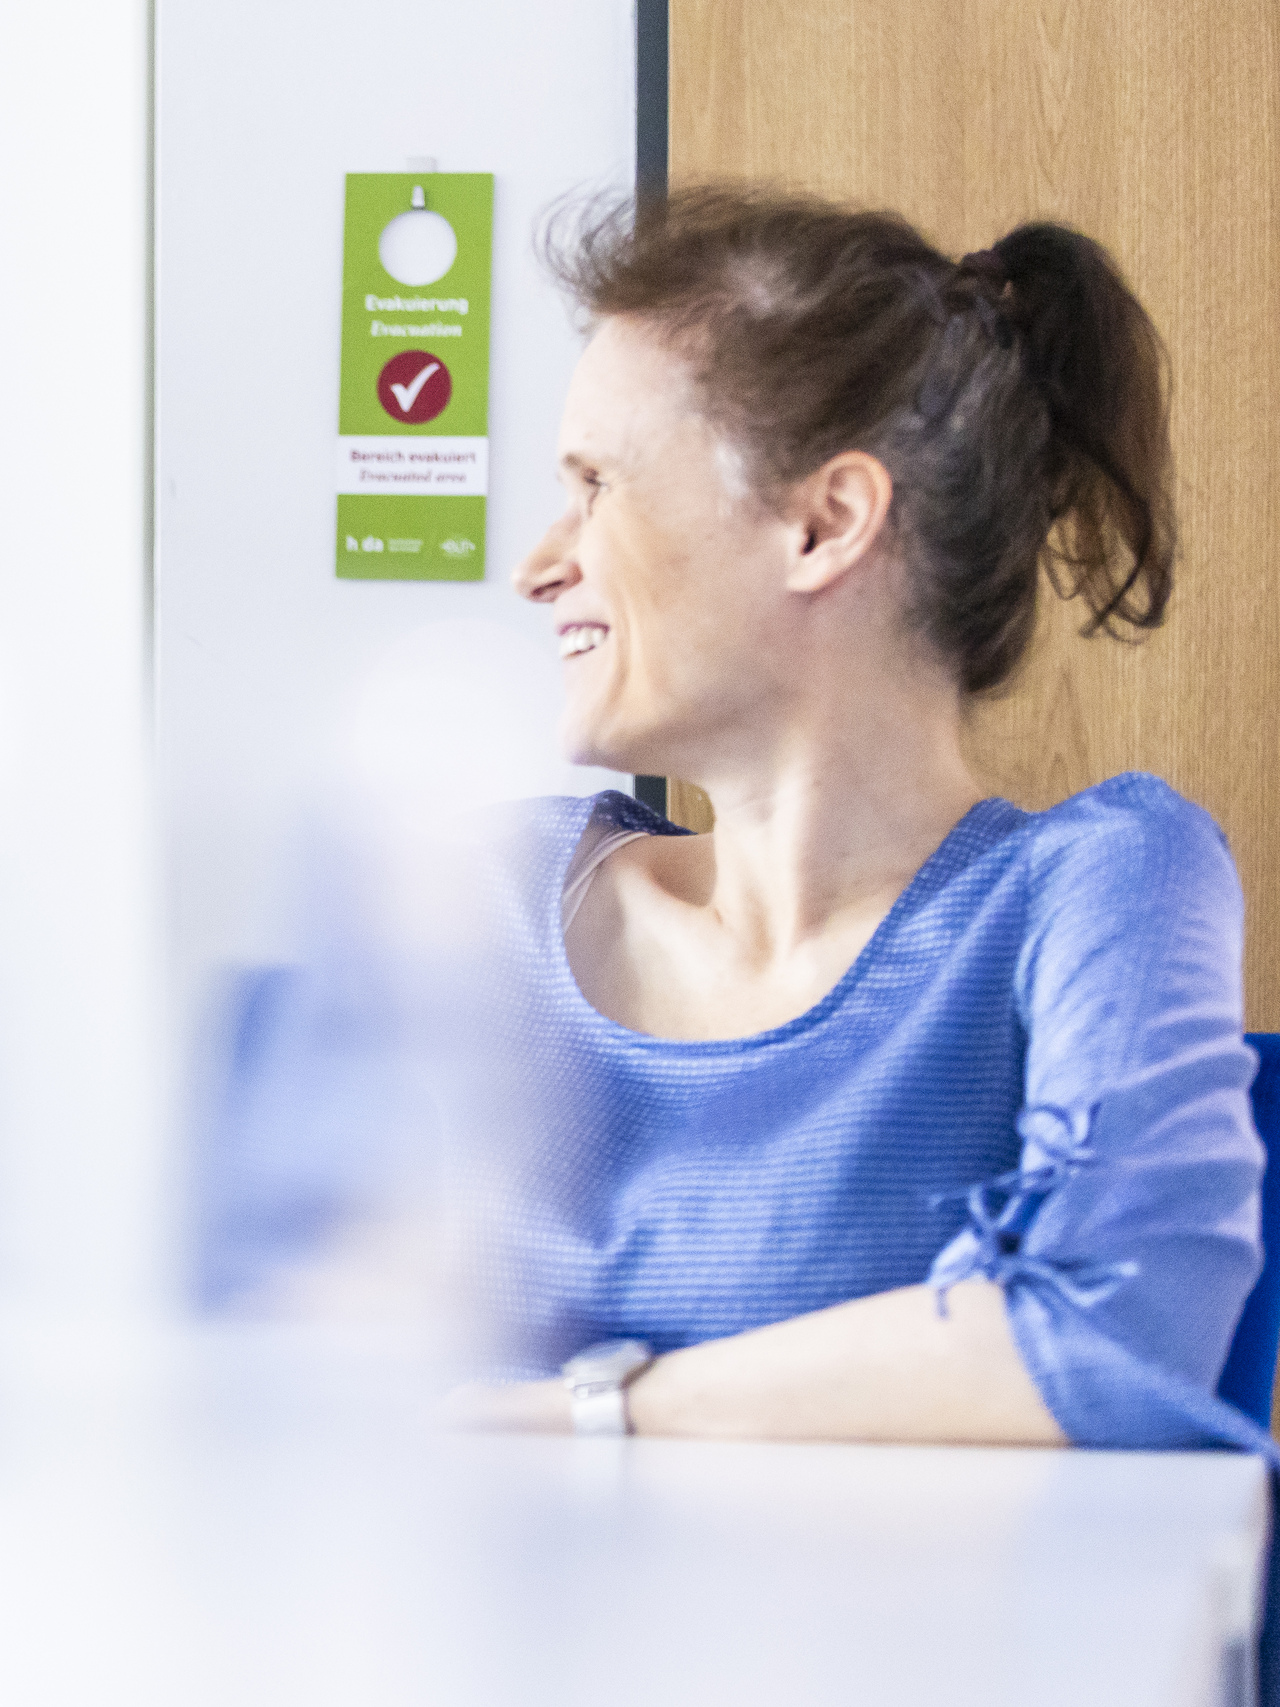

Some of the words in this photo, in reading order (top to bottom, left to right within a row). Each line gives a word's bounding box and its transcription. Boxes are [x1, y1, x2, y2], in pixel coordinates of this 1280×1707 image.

[365, 294, 469, 315] Evakuierung
[371, 320, 462, 337] Evacuation
[350, 450, 405, 463] Bereich
[409, 451, 476, 464] evakuiert
